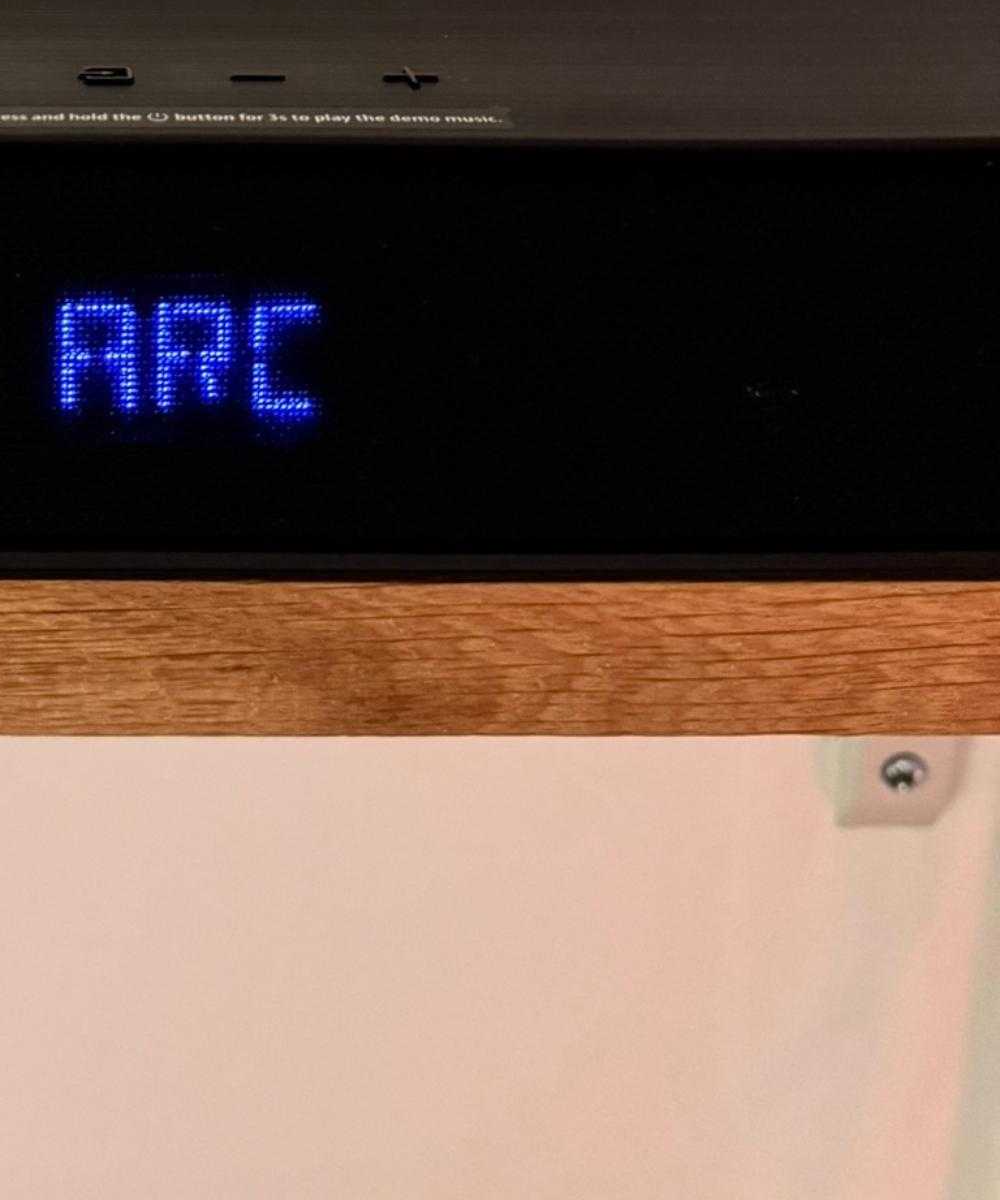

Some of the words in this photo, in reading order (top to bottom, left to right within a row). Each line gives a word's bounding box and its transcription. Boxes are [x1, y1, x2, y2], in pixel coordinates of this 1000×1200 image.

[30, 111, 66, 123] and
[68, 111, 109, 123] hold
[111, 111, 144, 123] the
[173, 111, 236, 123] button
[238, 111, 265, 123] for
[268, 112, 289, 123] 3s
[290, 112, 312, 123] to
[313, 112, 352, 125] play
[354, 112, 387, 124] the
[388, 112, 442, 124] demo
[444, 113, 505, 125] music.
[56, 295, 320, 417] ARC
